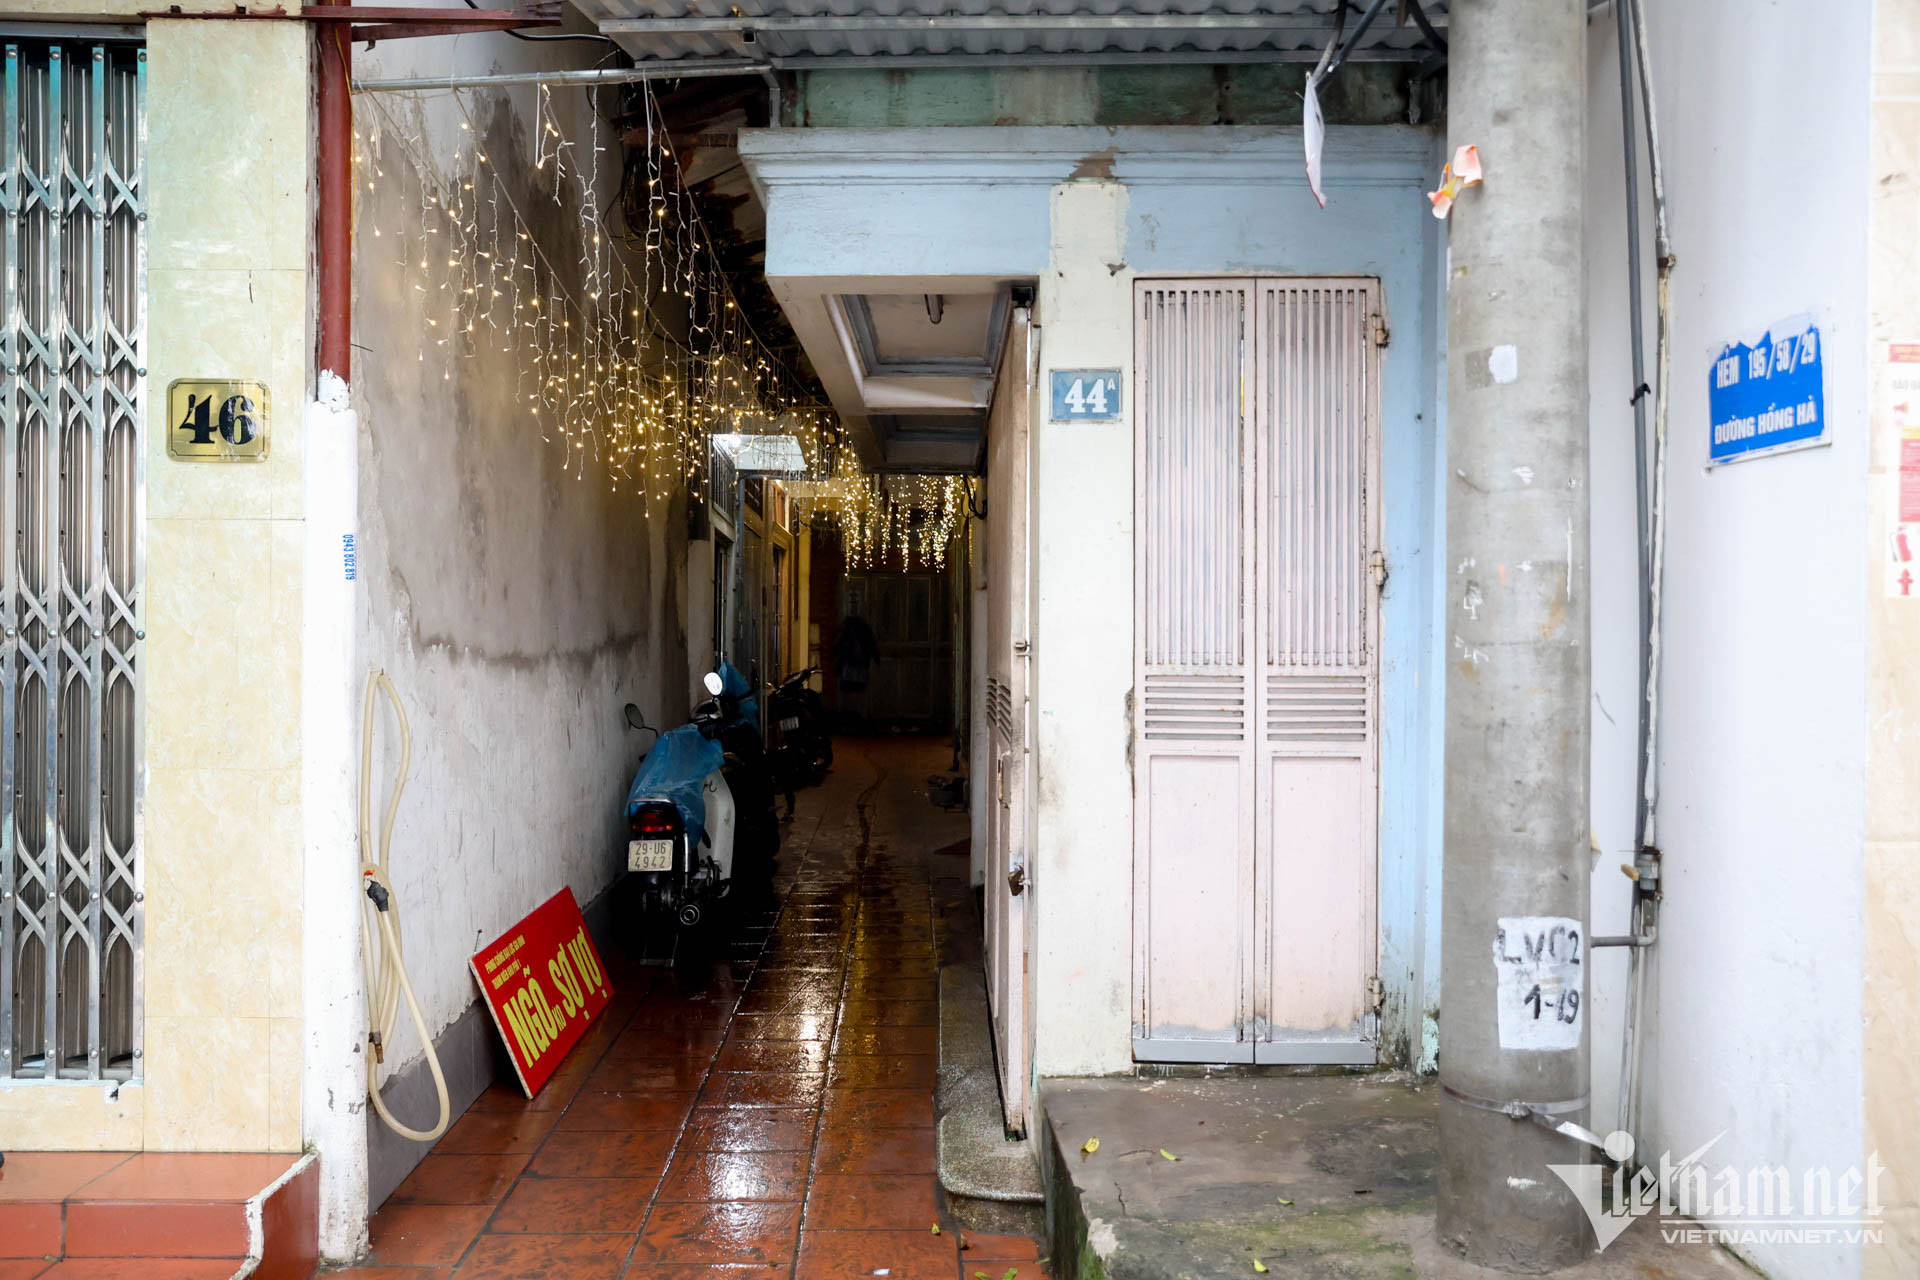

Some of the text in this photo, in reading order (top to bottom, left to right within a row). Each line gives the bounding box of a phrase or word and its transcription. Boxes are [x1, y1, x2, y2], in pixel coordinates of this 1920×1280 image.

[1748, 331, 1817, 380] 195/58/29
[179, 394, 257, 445] 46
[1714, 395, 1817, 445] ĐƯỜNG HỒNG HÀ
[634, 856, 667, 869] 4942
[635, 842, 667, 856] 29-U6
[547, 942, 591, 1021] SỢ
[567, 926, 608, 999] VỢ
[502, 964, 559, 1069] NGÕ
[551, 1004, 567, 1032] KO
